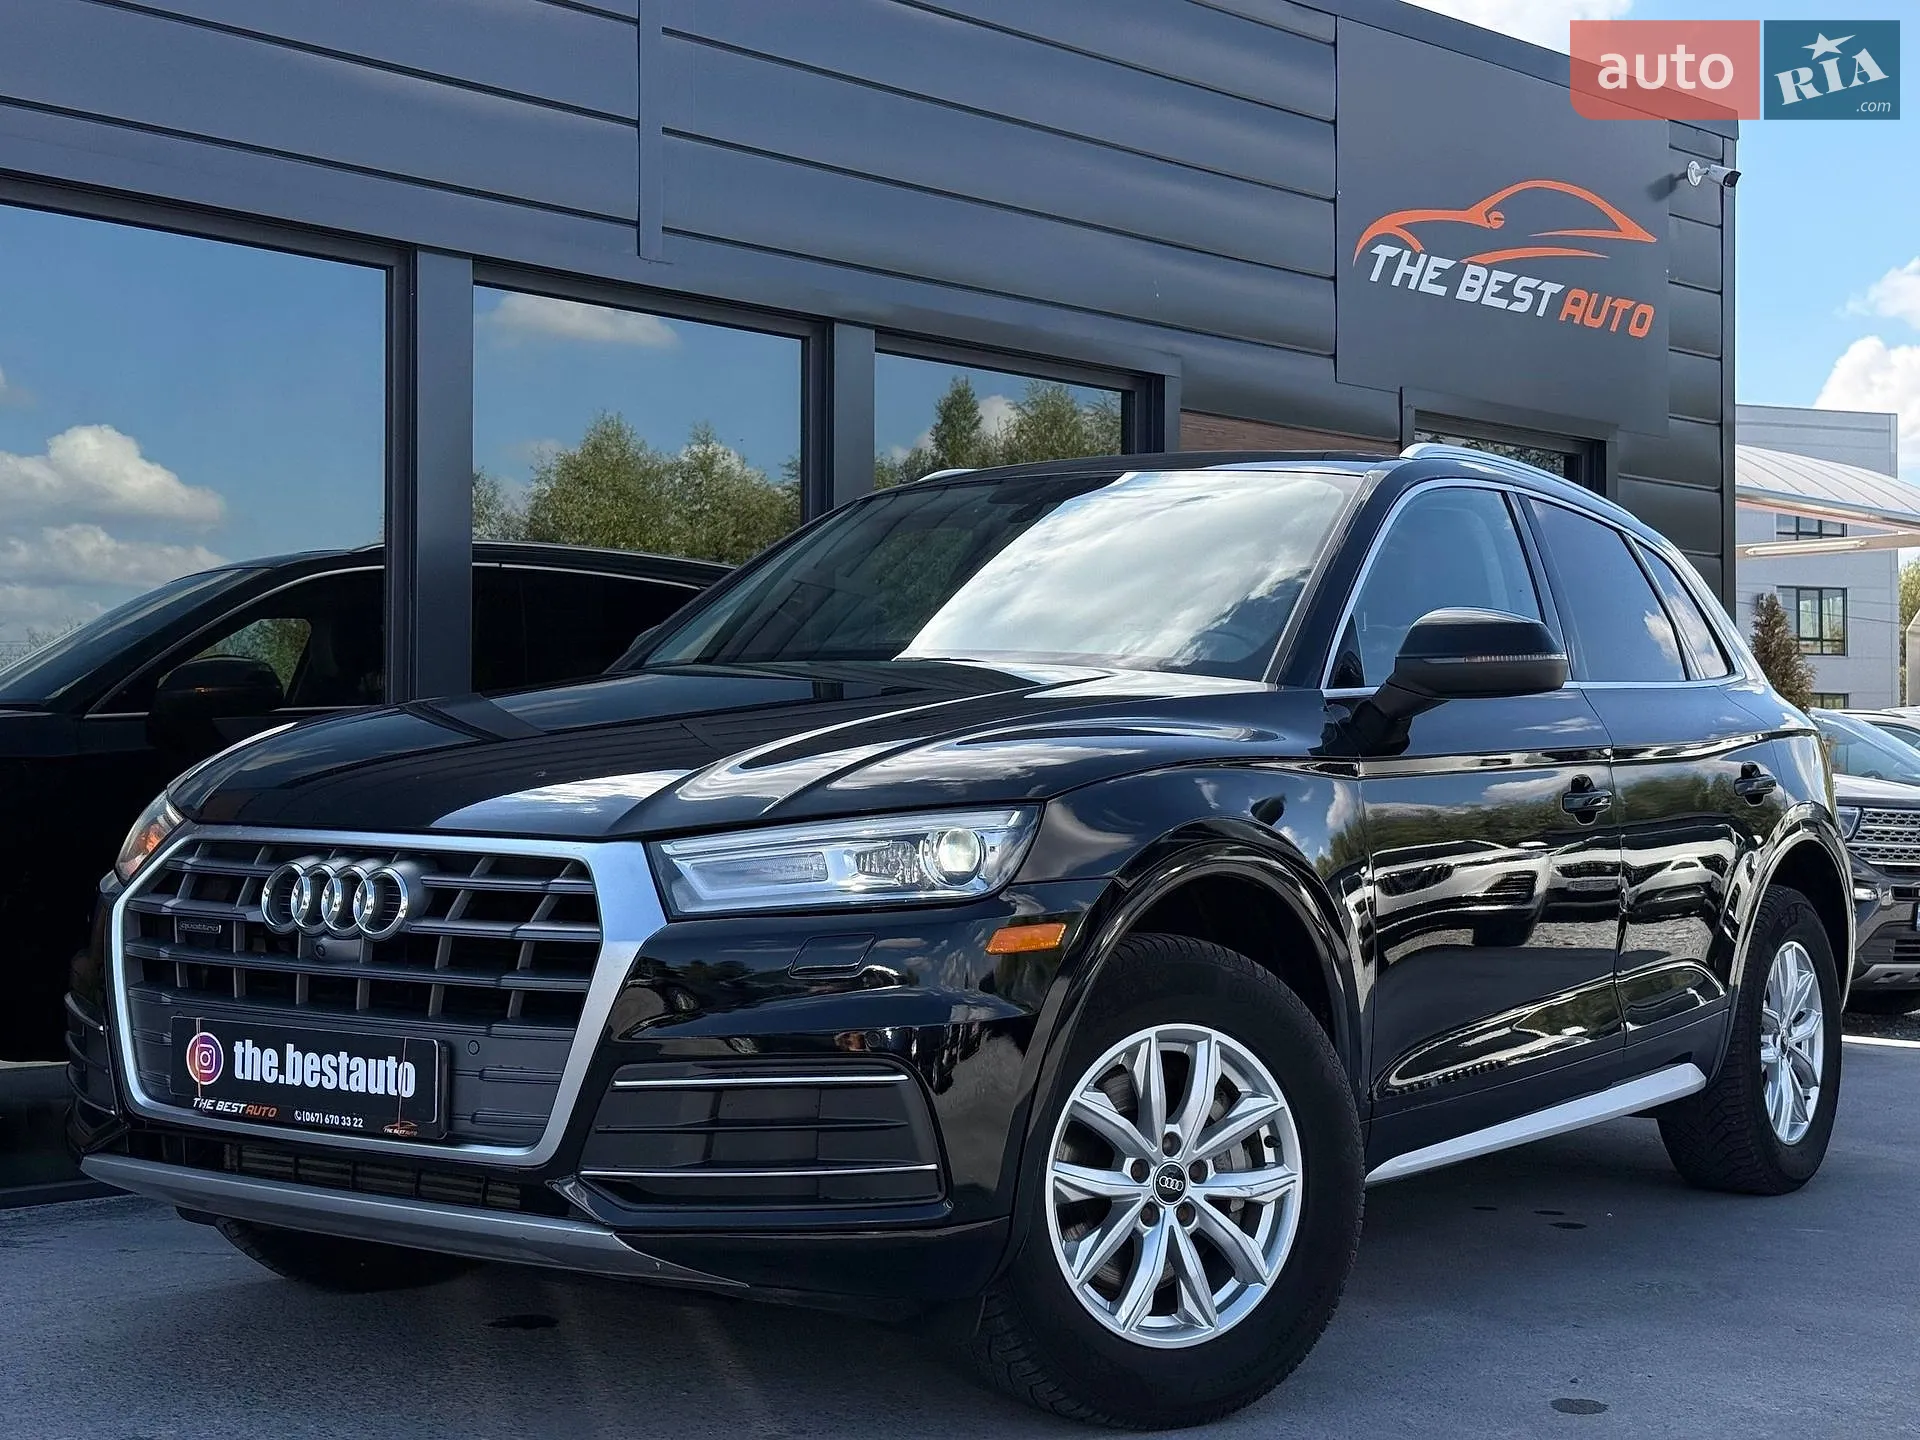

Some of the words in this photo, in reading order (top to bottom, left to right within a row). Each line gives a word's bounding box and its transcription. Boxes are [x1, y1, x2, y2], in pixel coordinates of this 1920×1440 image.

[1369, 244, 1457, 296] THE
[1455, 263, 1564, 317] BEST
[1558, 287, 1655, 338] AUTO
[233, 1039, 416, 1098] the.bestauto
[193, 1097, 214, 1110] THE
[215, 1100, 247, 1114] BEST
[245, 1104, 277, 1118] AUTO
[302, 1111, 323, 1124] (067)
[324, 1113, 340, 1126] 670
[340, 1116, 352, 1126] 33
[352, 1117, 364, 1128] 22
